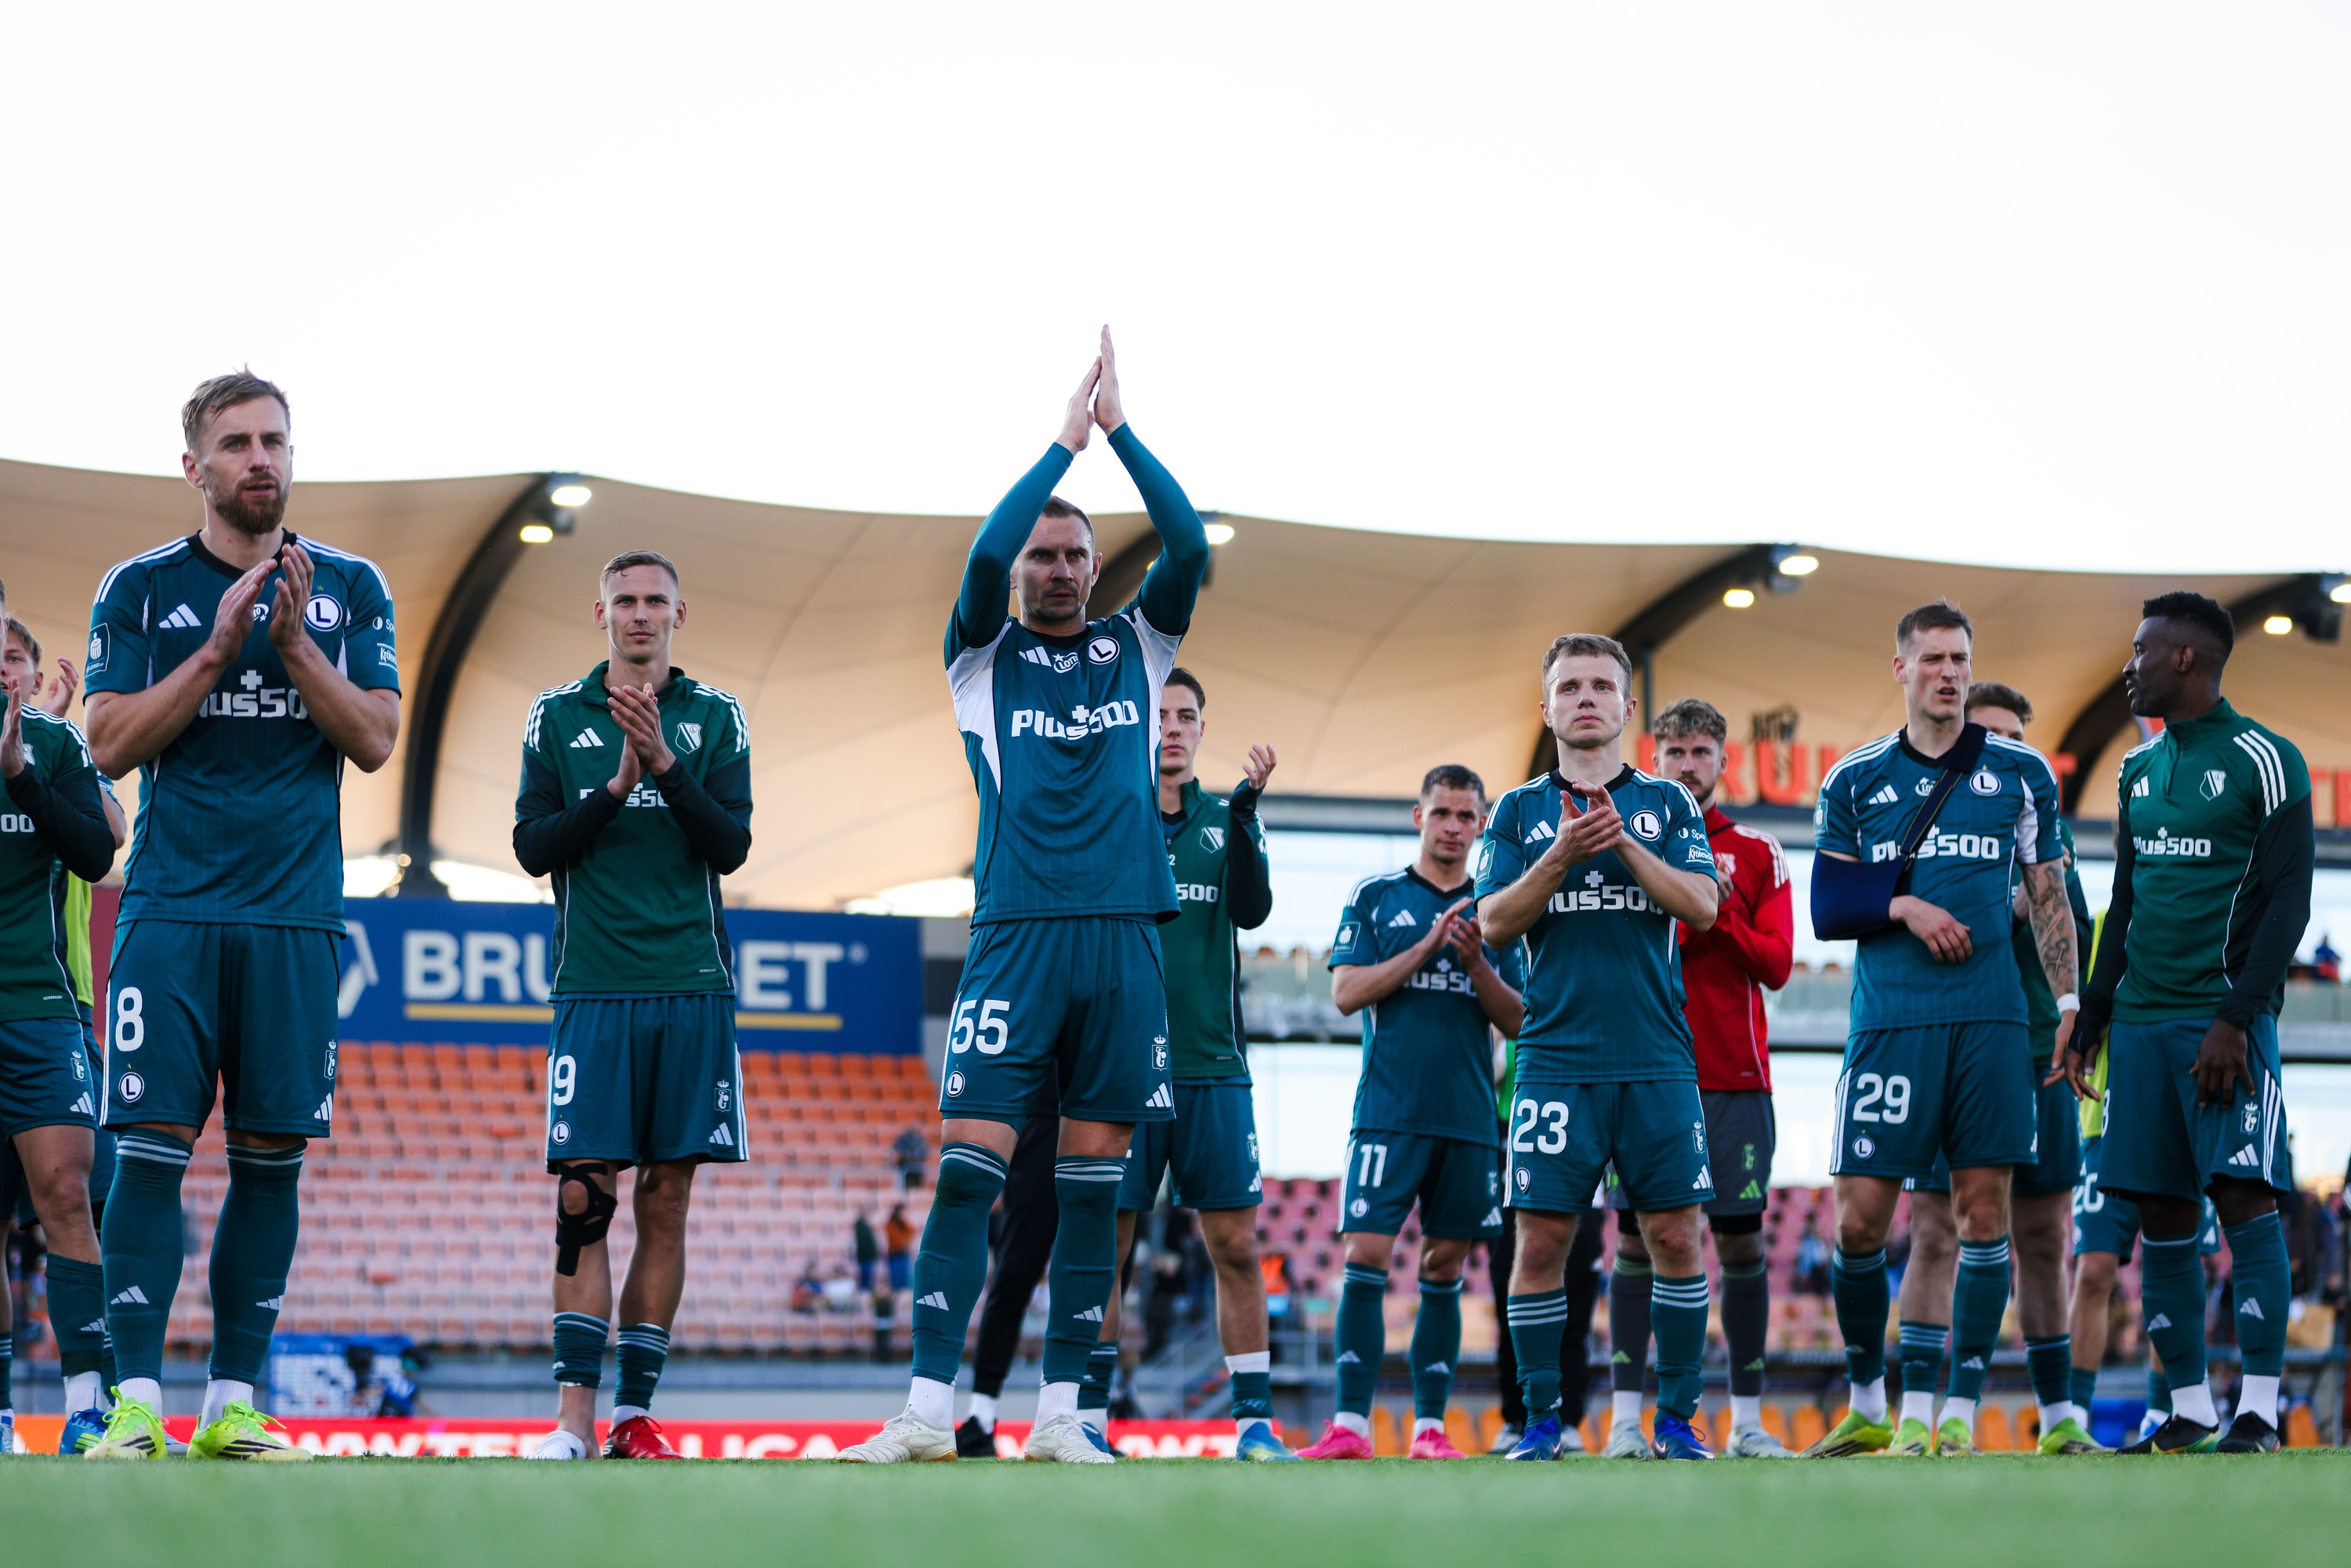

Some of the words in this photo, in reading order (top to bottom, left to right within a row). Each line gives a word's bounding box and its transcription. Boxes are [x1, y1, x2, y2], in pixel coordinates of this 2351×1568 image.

[198, 687, 309, 719] us50
[1011, 700, 1139, 741] Plus500
[1549, 885, 1665, 915] us50
[115, 987, 144, 1052] 8
[951, 999, 1010, 1055] 55
[553, 1055, 577, 1106] 9
[1853, 1072, 1911, 1125] 29
[1513, 1099, 1570, 1155] 23
[1358, 1144, 1387, 1189] 11
